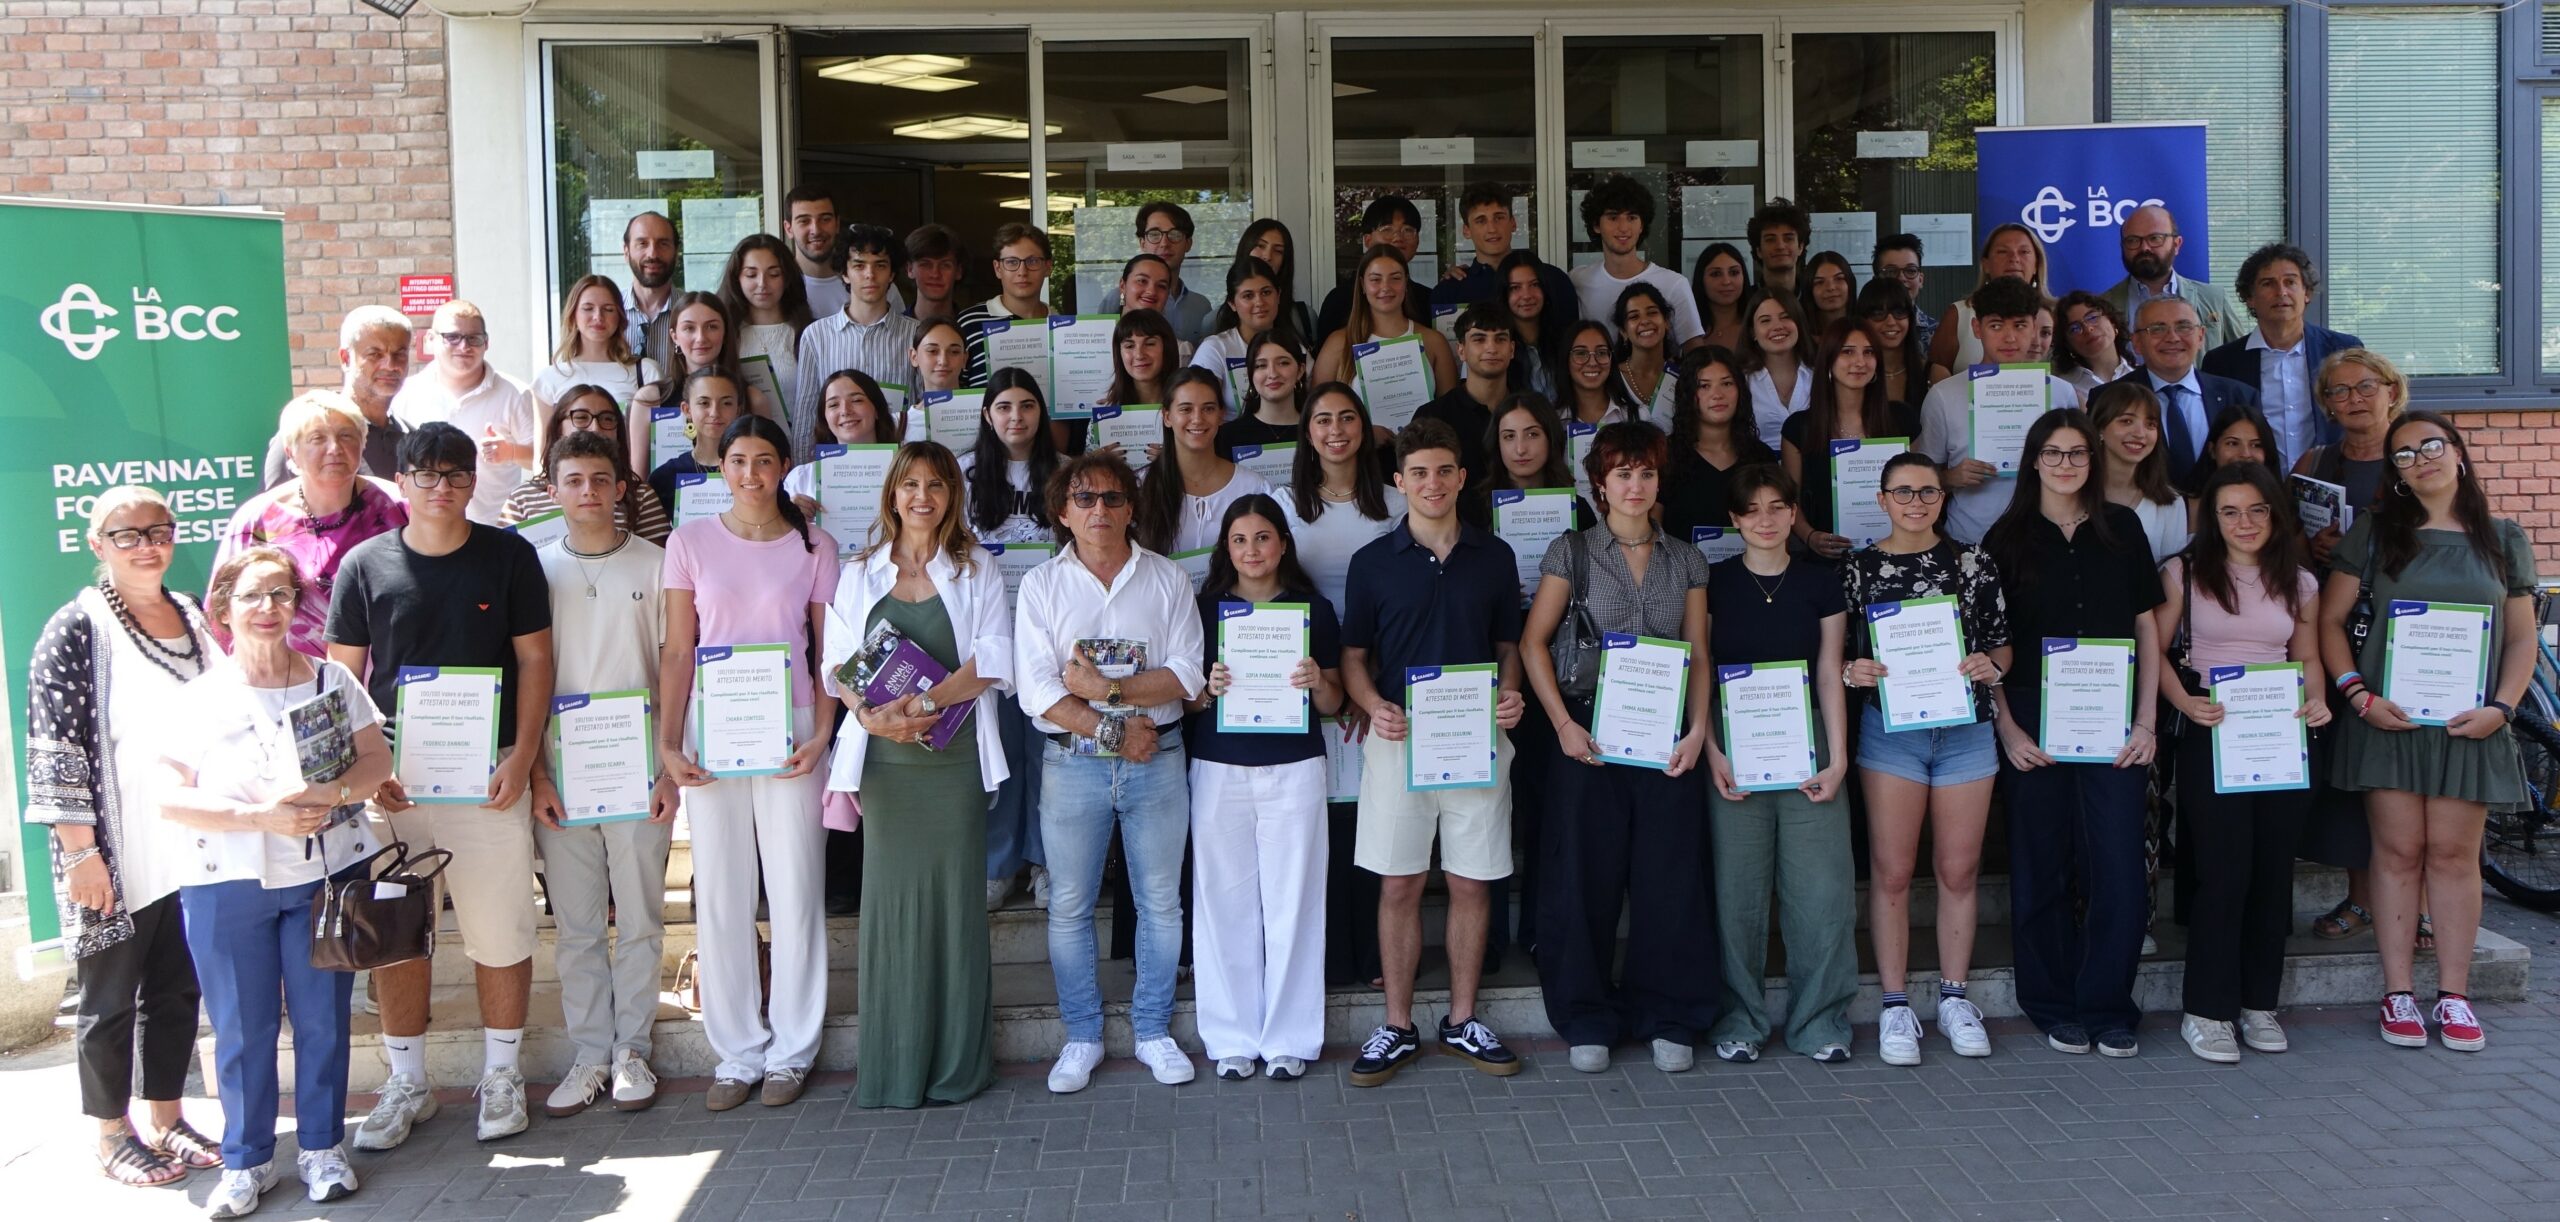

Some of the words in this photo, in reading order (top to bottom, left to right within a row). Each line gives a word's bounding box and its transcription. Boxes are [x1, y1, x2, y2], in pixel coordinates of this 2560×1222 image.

[2087, 186, 2109, 198] LA
[132, 286, 162, 303] LA
[134, 305, 241, 341] BCC
[53, 456, 255, 488] RAVENNATE
[58, 529, 80, 552] E
[1237, 632, 1264, 640] ATTESTATO
[1889, 629, 1917, 639] ATTESTATO
[1916, 628, 1923, 636] DI
[1923, 626, 1944, 635] MERITO
[884, 660, 909, 691] ANNALI
[1617, 664, 1644, 674] ATTESTATO
[1650, 668, 1670, 677] MERITO
[716, 675, 744, 684] ATTESTATO
[752, 674, 772, 682] MERITO
[890, 683, 901, 695] DEL
[900, 664, 914, 683] LICEO
[418, 698, 449, 706] ATTESTATO
[1425, 694, 1452, 702] ATTESTATO
[1739, 692, 1766, 701] ATTESTATO
[1772, 690, 1792, 698] MERITO
[574, 722, 603, 732] ATTESTATO
[610, 720, 632, 729] MERITO
